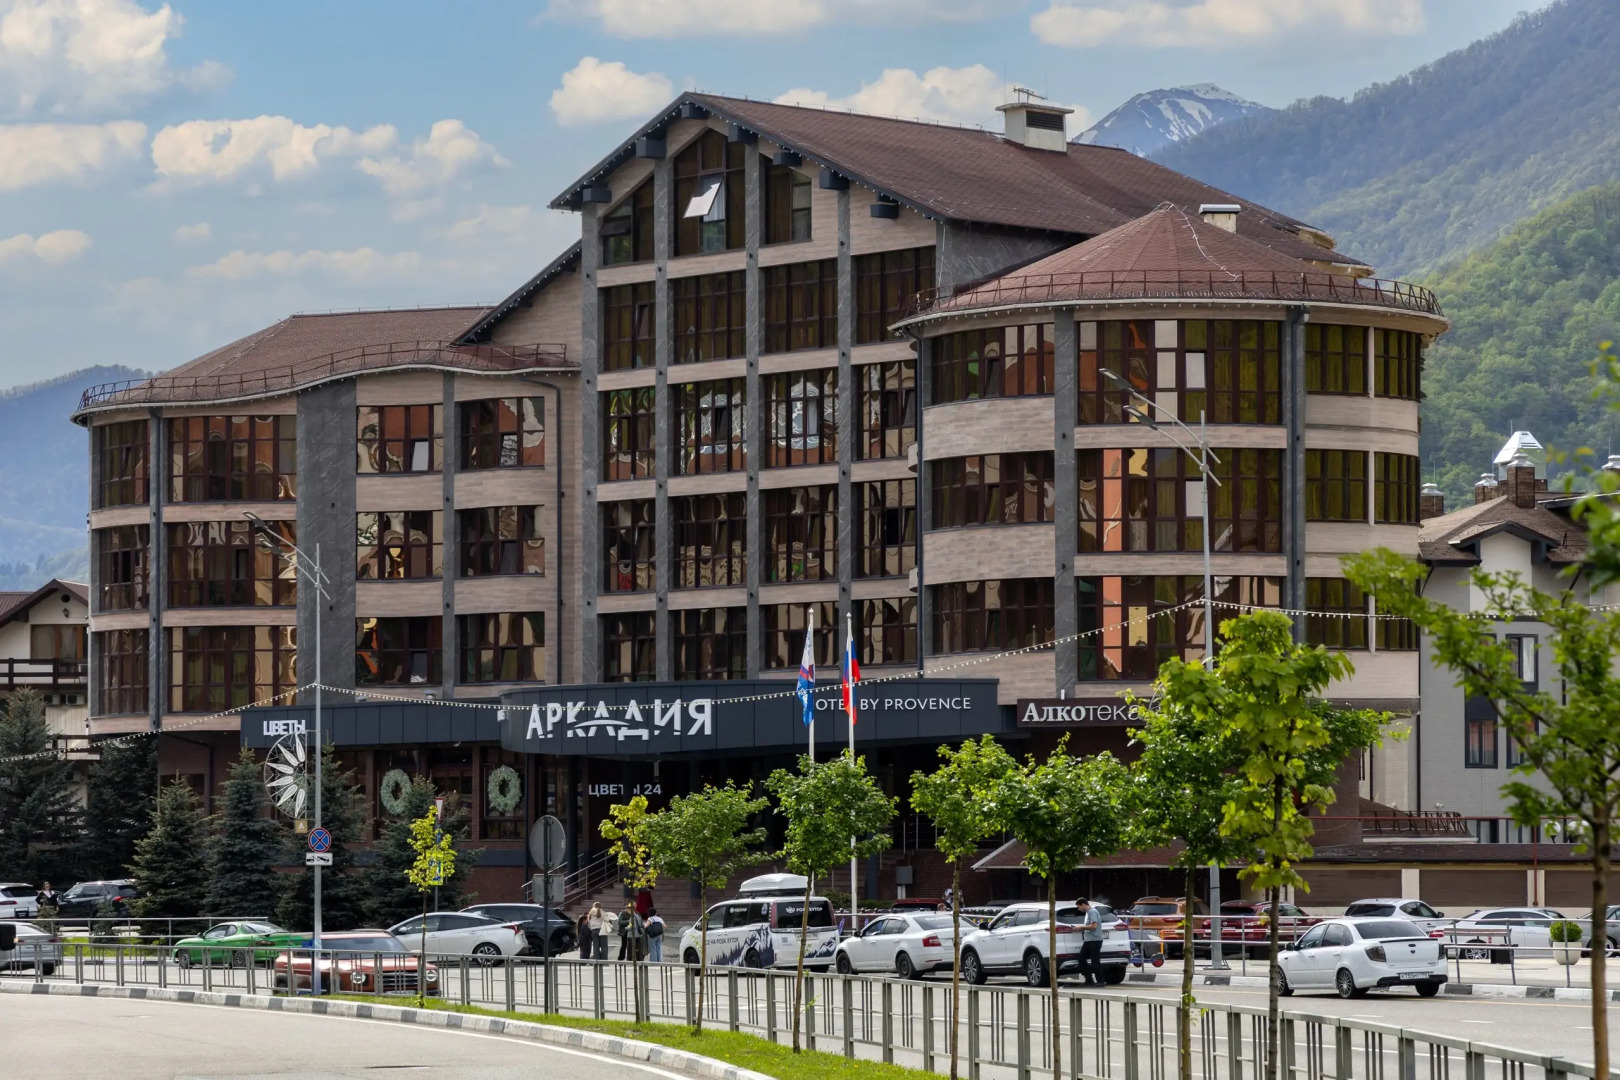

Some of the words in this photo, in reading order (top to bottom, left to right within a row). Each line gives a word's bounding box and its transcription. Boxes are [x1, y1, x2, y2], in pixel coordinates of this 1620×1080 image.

[860, 698, 879, 710] BY
[884, 697, 972, 710] PROVENCE
[525, 698, 712, 741] АРКАДИЯ
[263, 719, 306, 736] ЦВЕТЫ
[644, 783, 661, 795] 24
